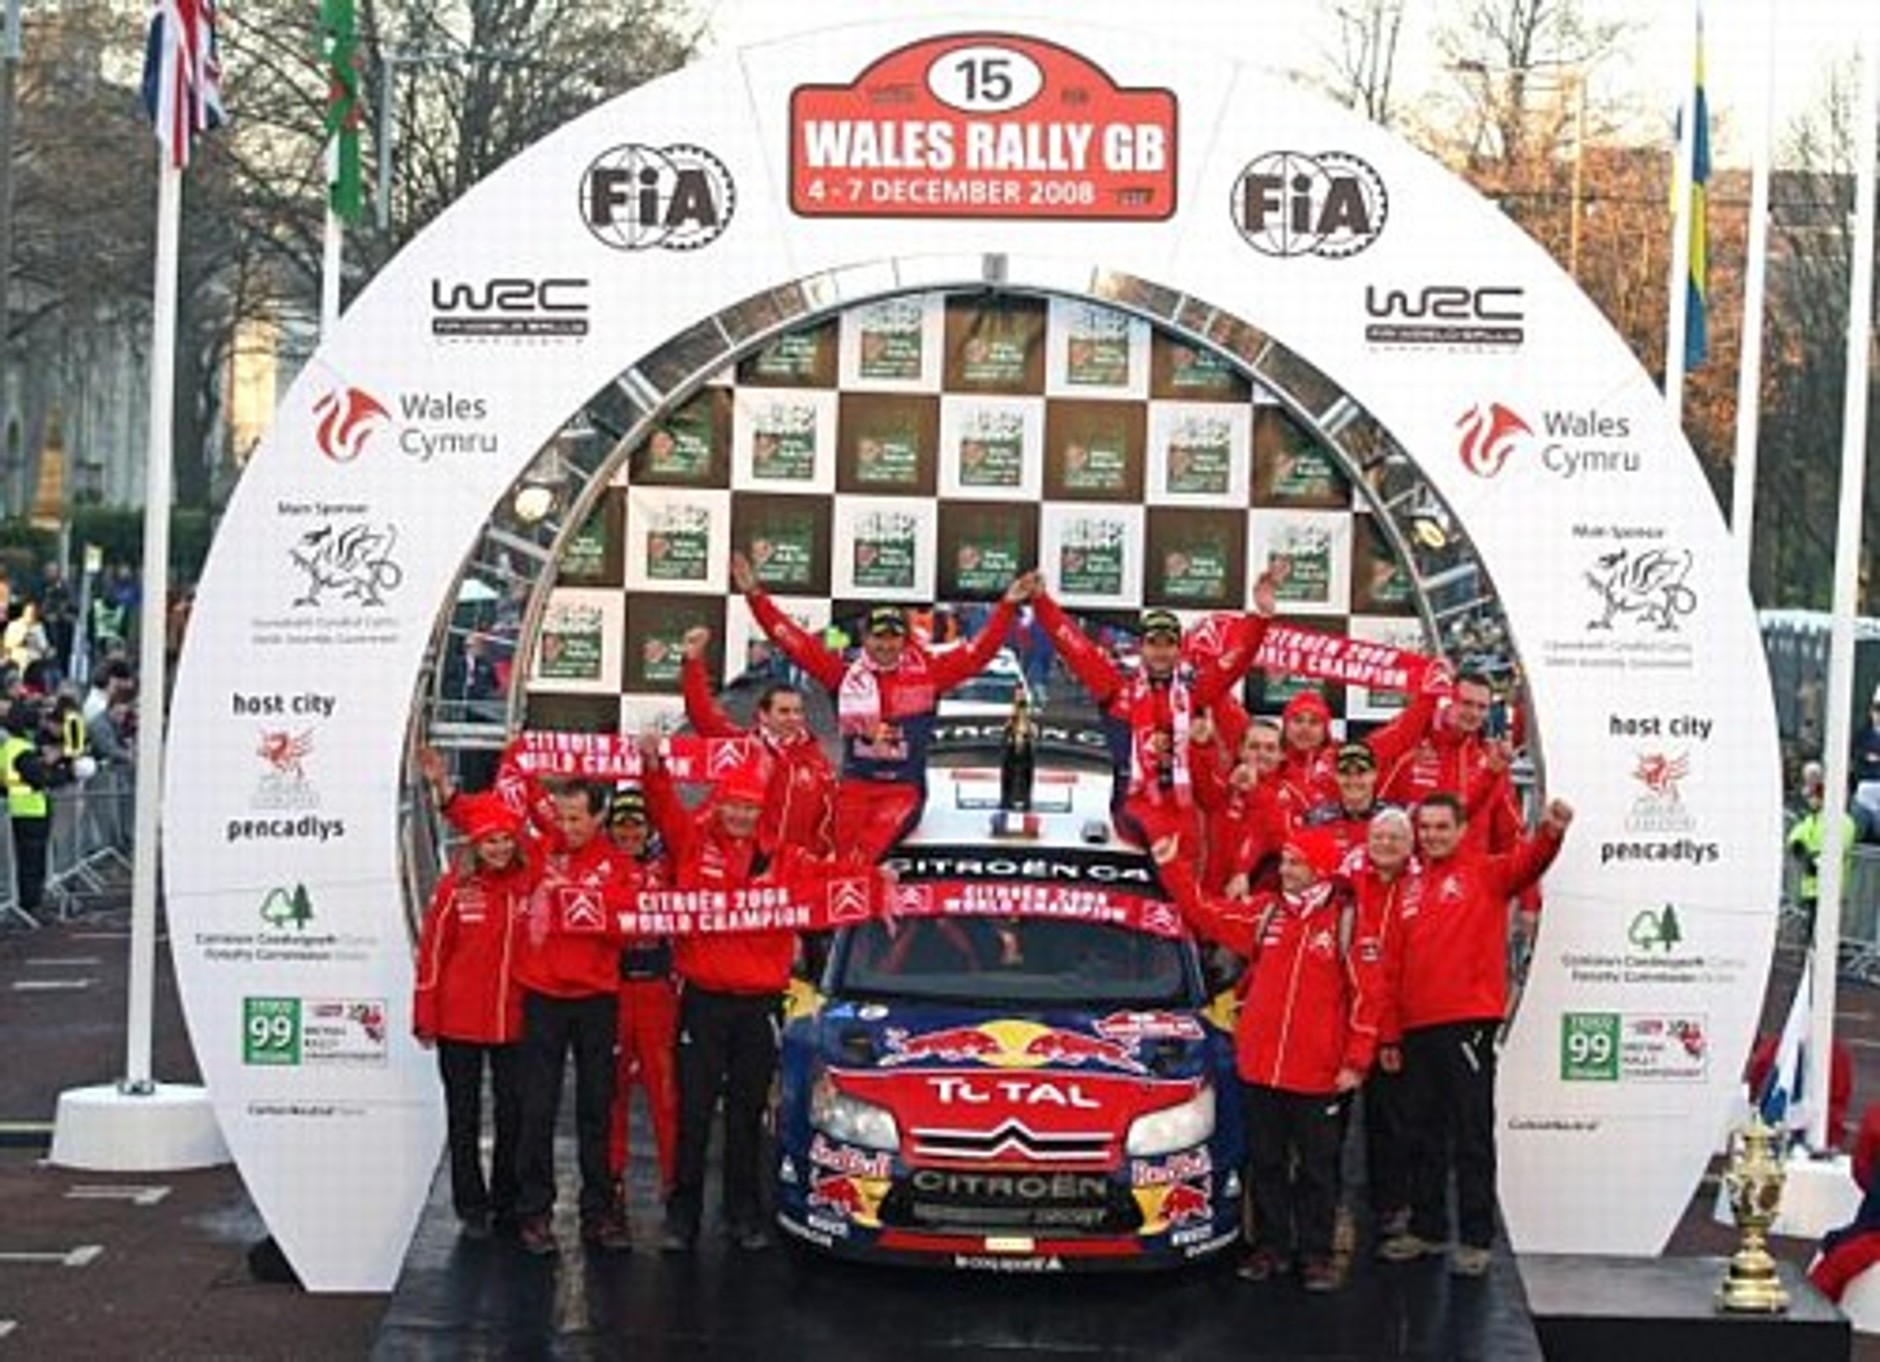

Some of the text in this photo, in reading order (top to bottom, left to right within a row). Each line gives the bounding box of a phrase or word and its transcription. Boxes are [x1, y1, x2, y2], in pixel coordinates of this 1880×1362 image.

[956, 58, 1013, 102] 15
[804, 120, 1165, 172] WALES RALLY GB
[808, 179, 823, 201] 4
[848, 180, 864, 201] 7
[871, 179, 1021, 203] DECEMBER
[1029, 180, 1095, 206] 2008
[432, 278, 589, 312] WRC
[1364, 284, 1525, 320] WRC
[399, 391, 488, 420] Wales
[1543, 409, 1631, 438] Wales
[398, 428, 499, 462] Cymru
[1541, 443, 1641, 479] Cymru
[232, 693, 336, 716] host city
[1608, 714, 1713, 740] host city
[226, 815, 345, 841] pencadlys
[1601, 838, 1720, 864] pencadlys
[616, 906, 811, 933] WORLD CHAMPION
[251, 1016, 293, 1048] 99
[1568, 1030, 1612, 1063] 99
